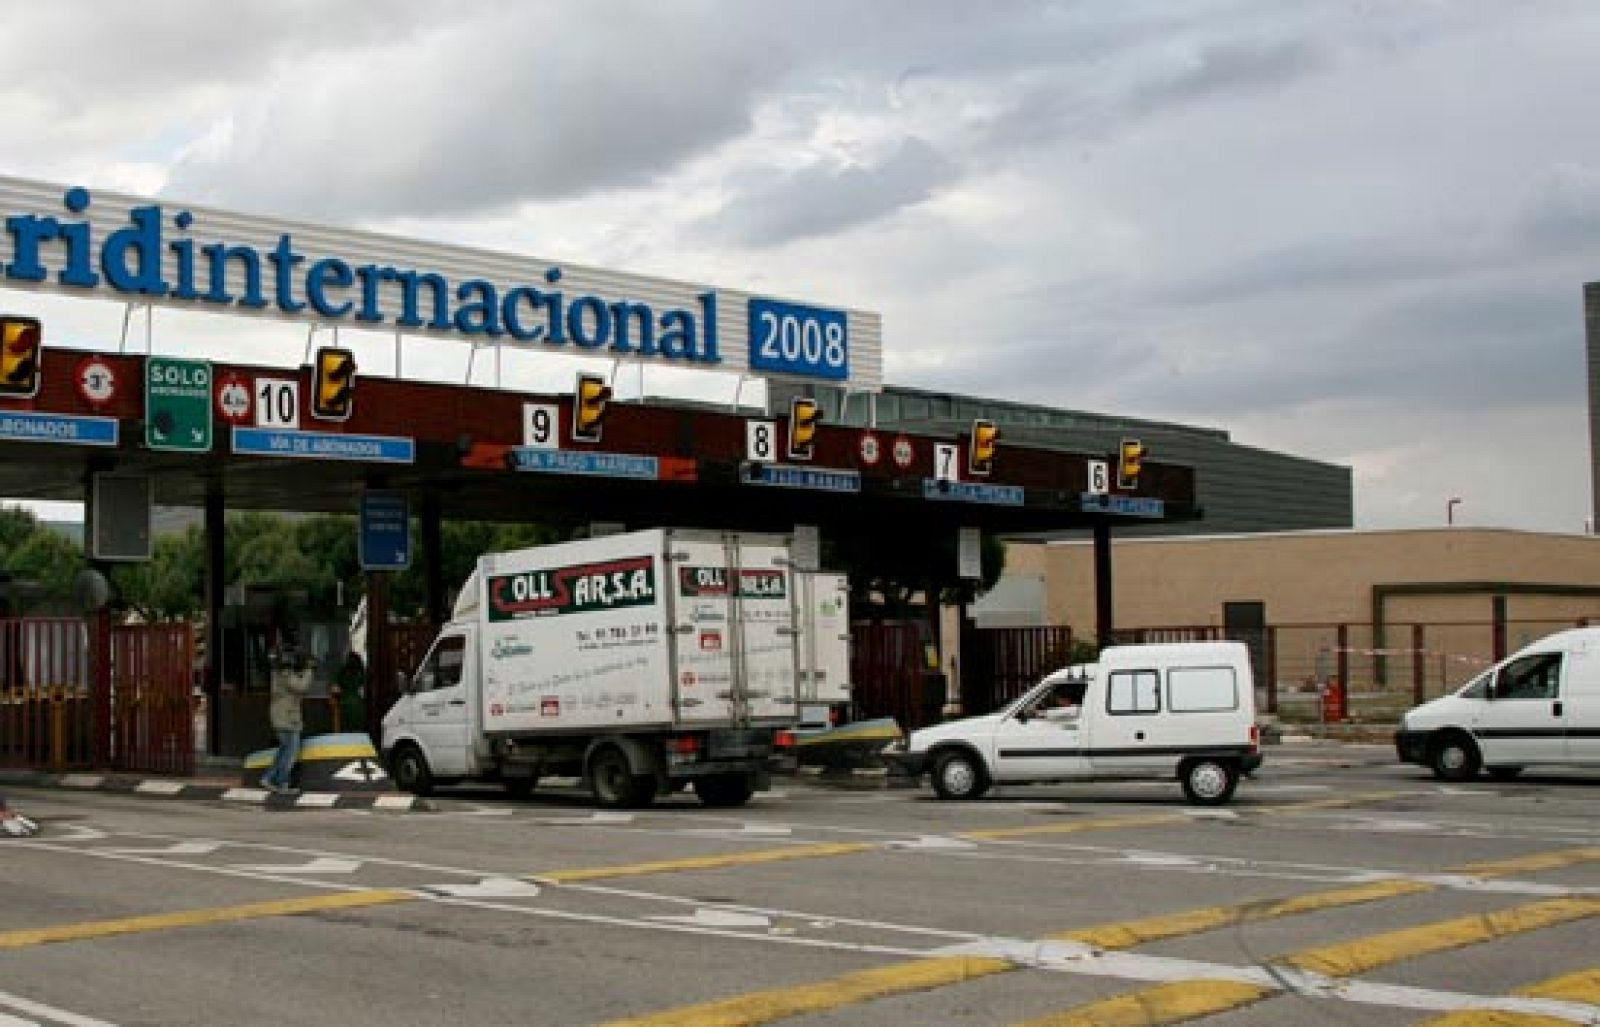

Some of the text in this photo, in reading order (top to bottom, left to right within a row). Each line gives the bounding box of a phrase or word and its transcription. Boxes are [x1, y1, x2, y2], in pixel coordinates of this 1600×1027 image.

[0, 187, 722, 365] ridinternacional
[758, 310, 847, 368] 2008
[150, 365, 208, 386] SOLO
[260, 383, 295, 423] 10
[532, 408, 550, 443] 9
[755, 424, 769, 457] 8
[940, 446, 954, 476] 7
[1092, 463, 1104, 490] 6
